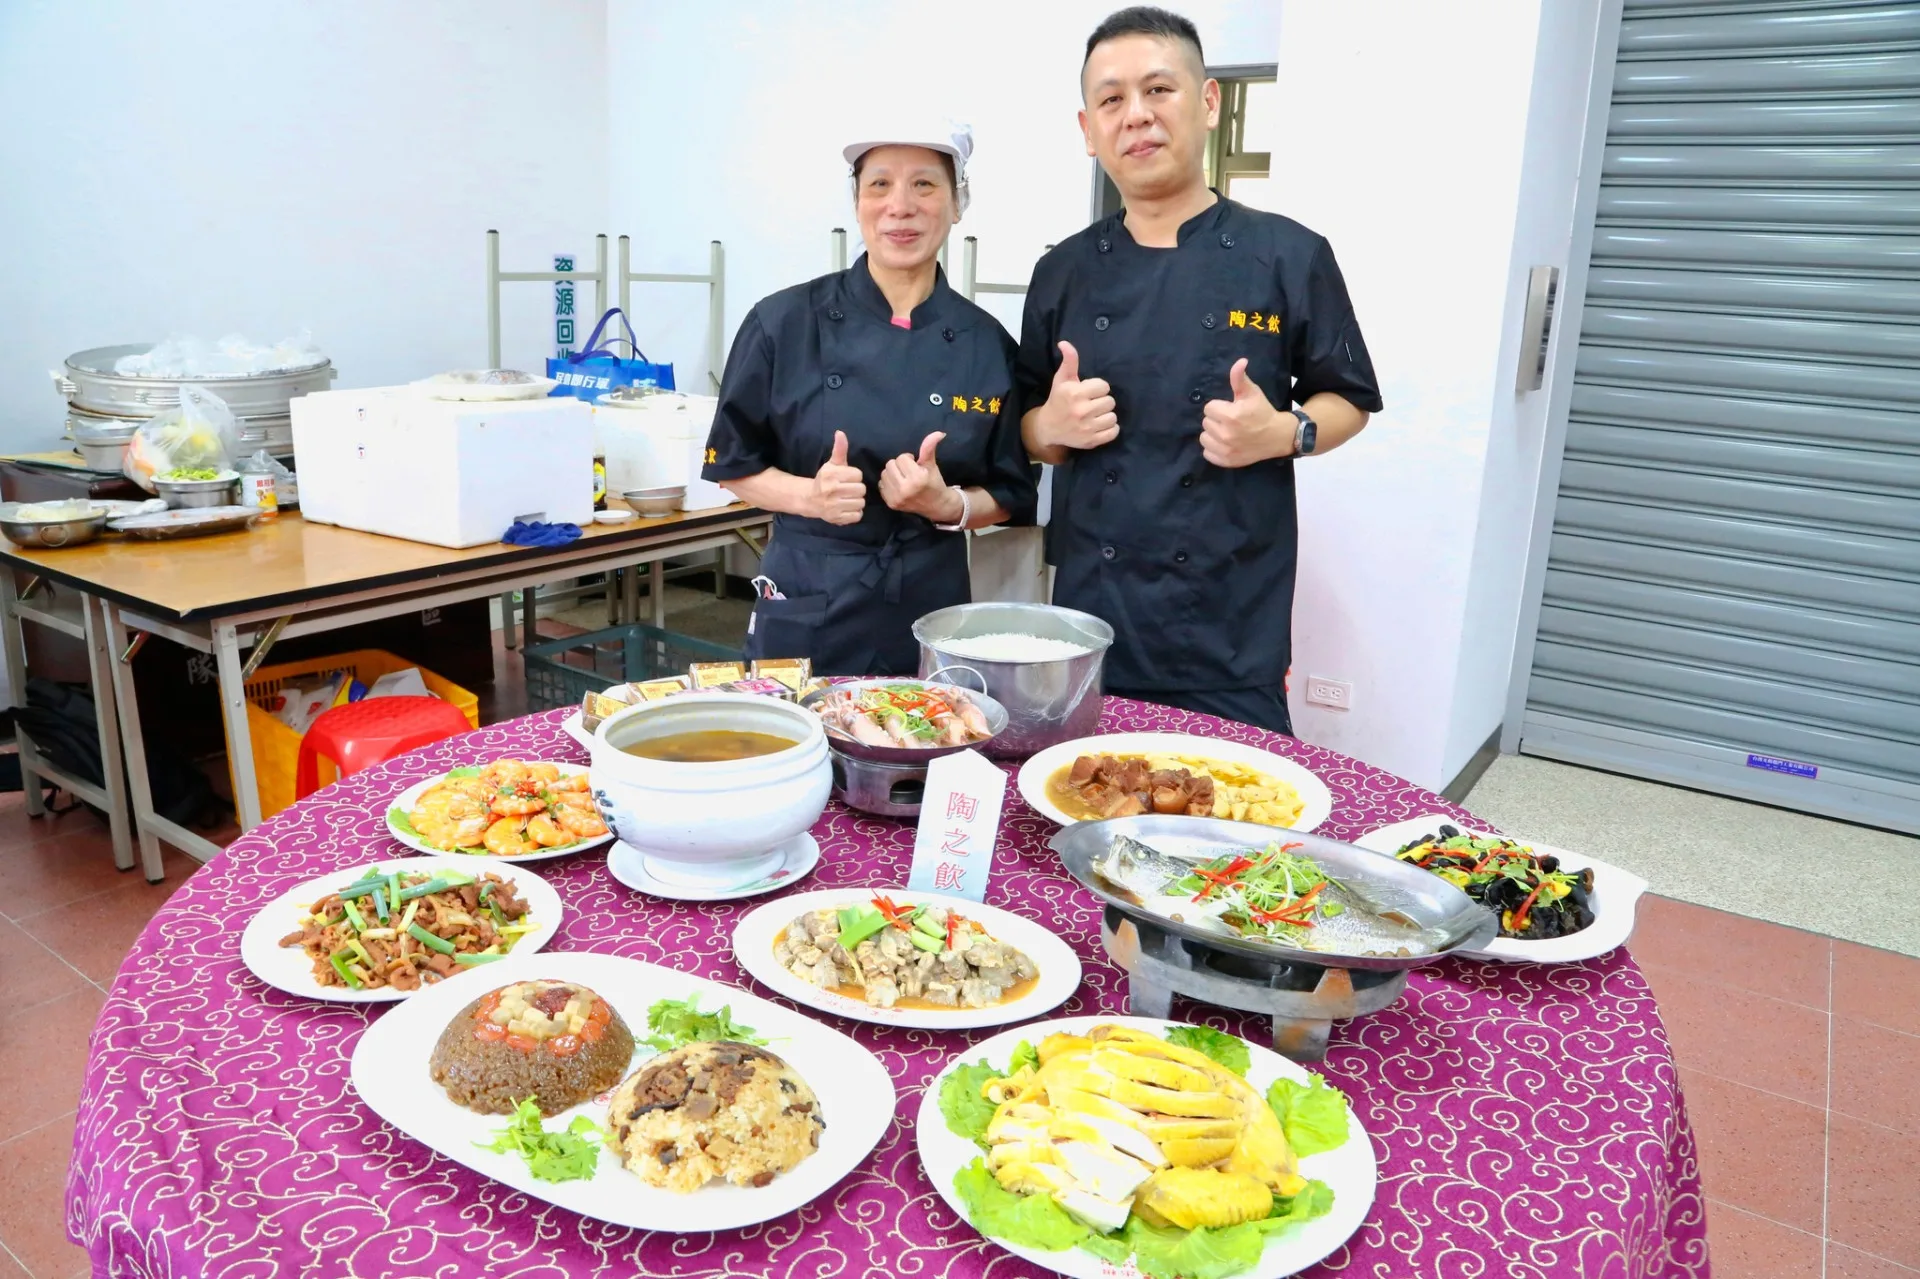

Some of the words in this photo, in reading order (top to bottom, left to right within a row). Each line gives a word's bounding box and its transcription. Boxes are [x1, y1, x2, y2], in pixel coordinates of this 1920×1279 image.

[1229, 310, 1281, 334] 陶之飲
[952, 395, 1001, 414] 陶之飲
[934, 791, 978, 890] 陶之飲
